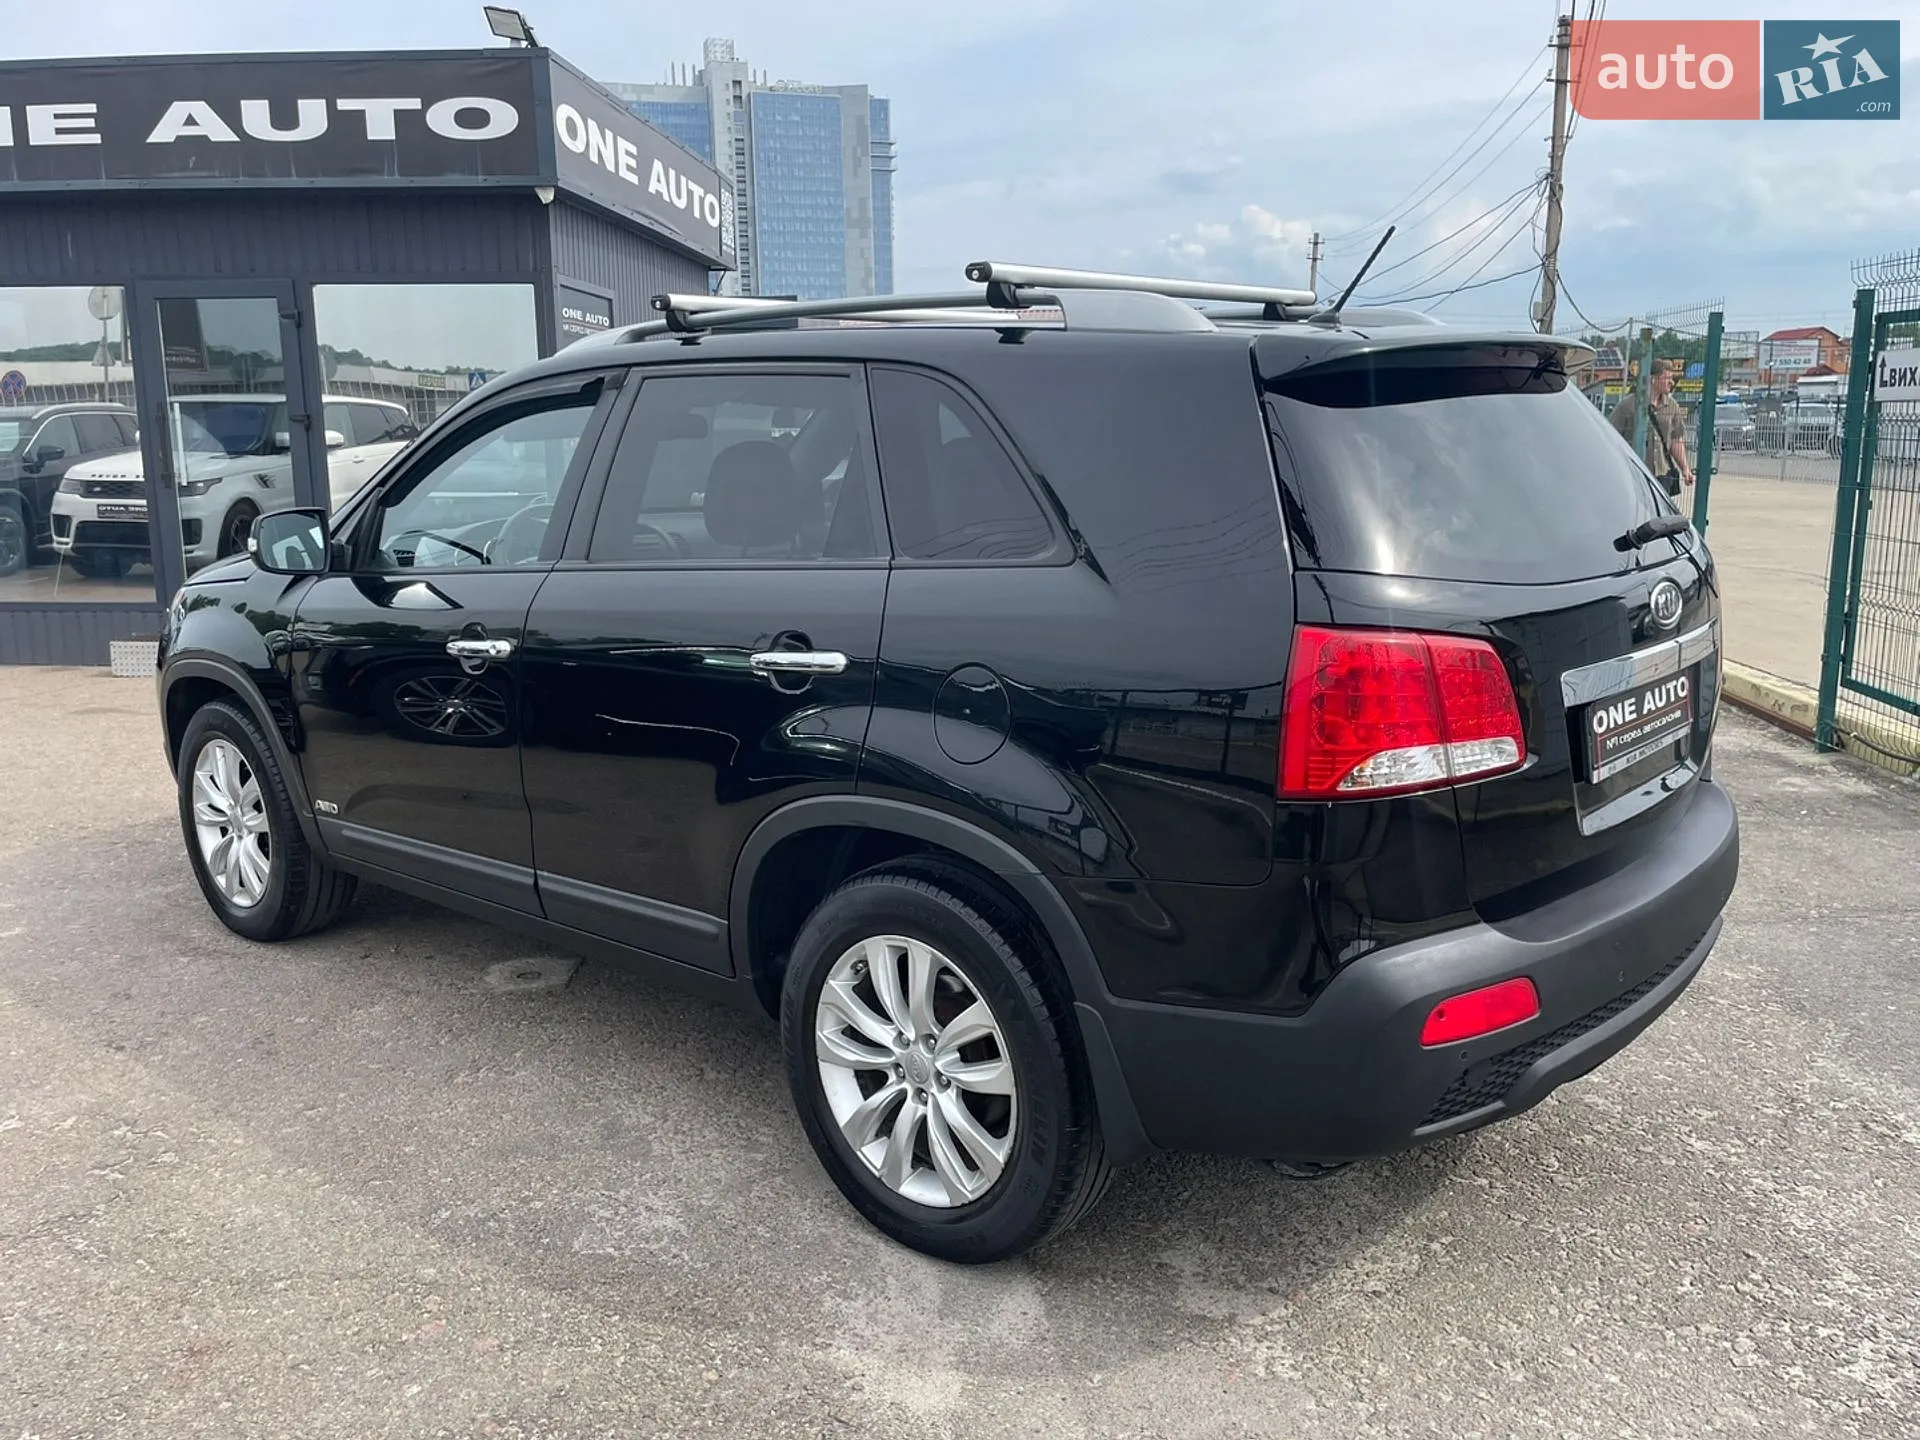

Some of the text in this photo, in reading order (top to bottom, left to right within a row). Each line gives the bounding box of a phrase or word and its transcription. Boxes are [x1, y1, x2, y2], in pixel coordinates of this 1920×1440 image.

[0, 97, 519, 147] E AUTO
[555, 103, 720, 229] ONE AUTO
[562, 307, 610, 327] ONE AUTO
[1889, 366, 1920, 387] ВИХ
[1593, 676, 1689, 734] ONE AUTO
